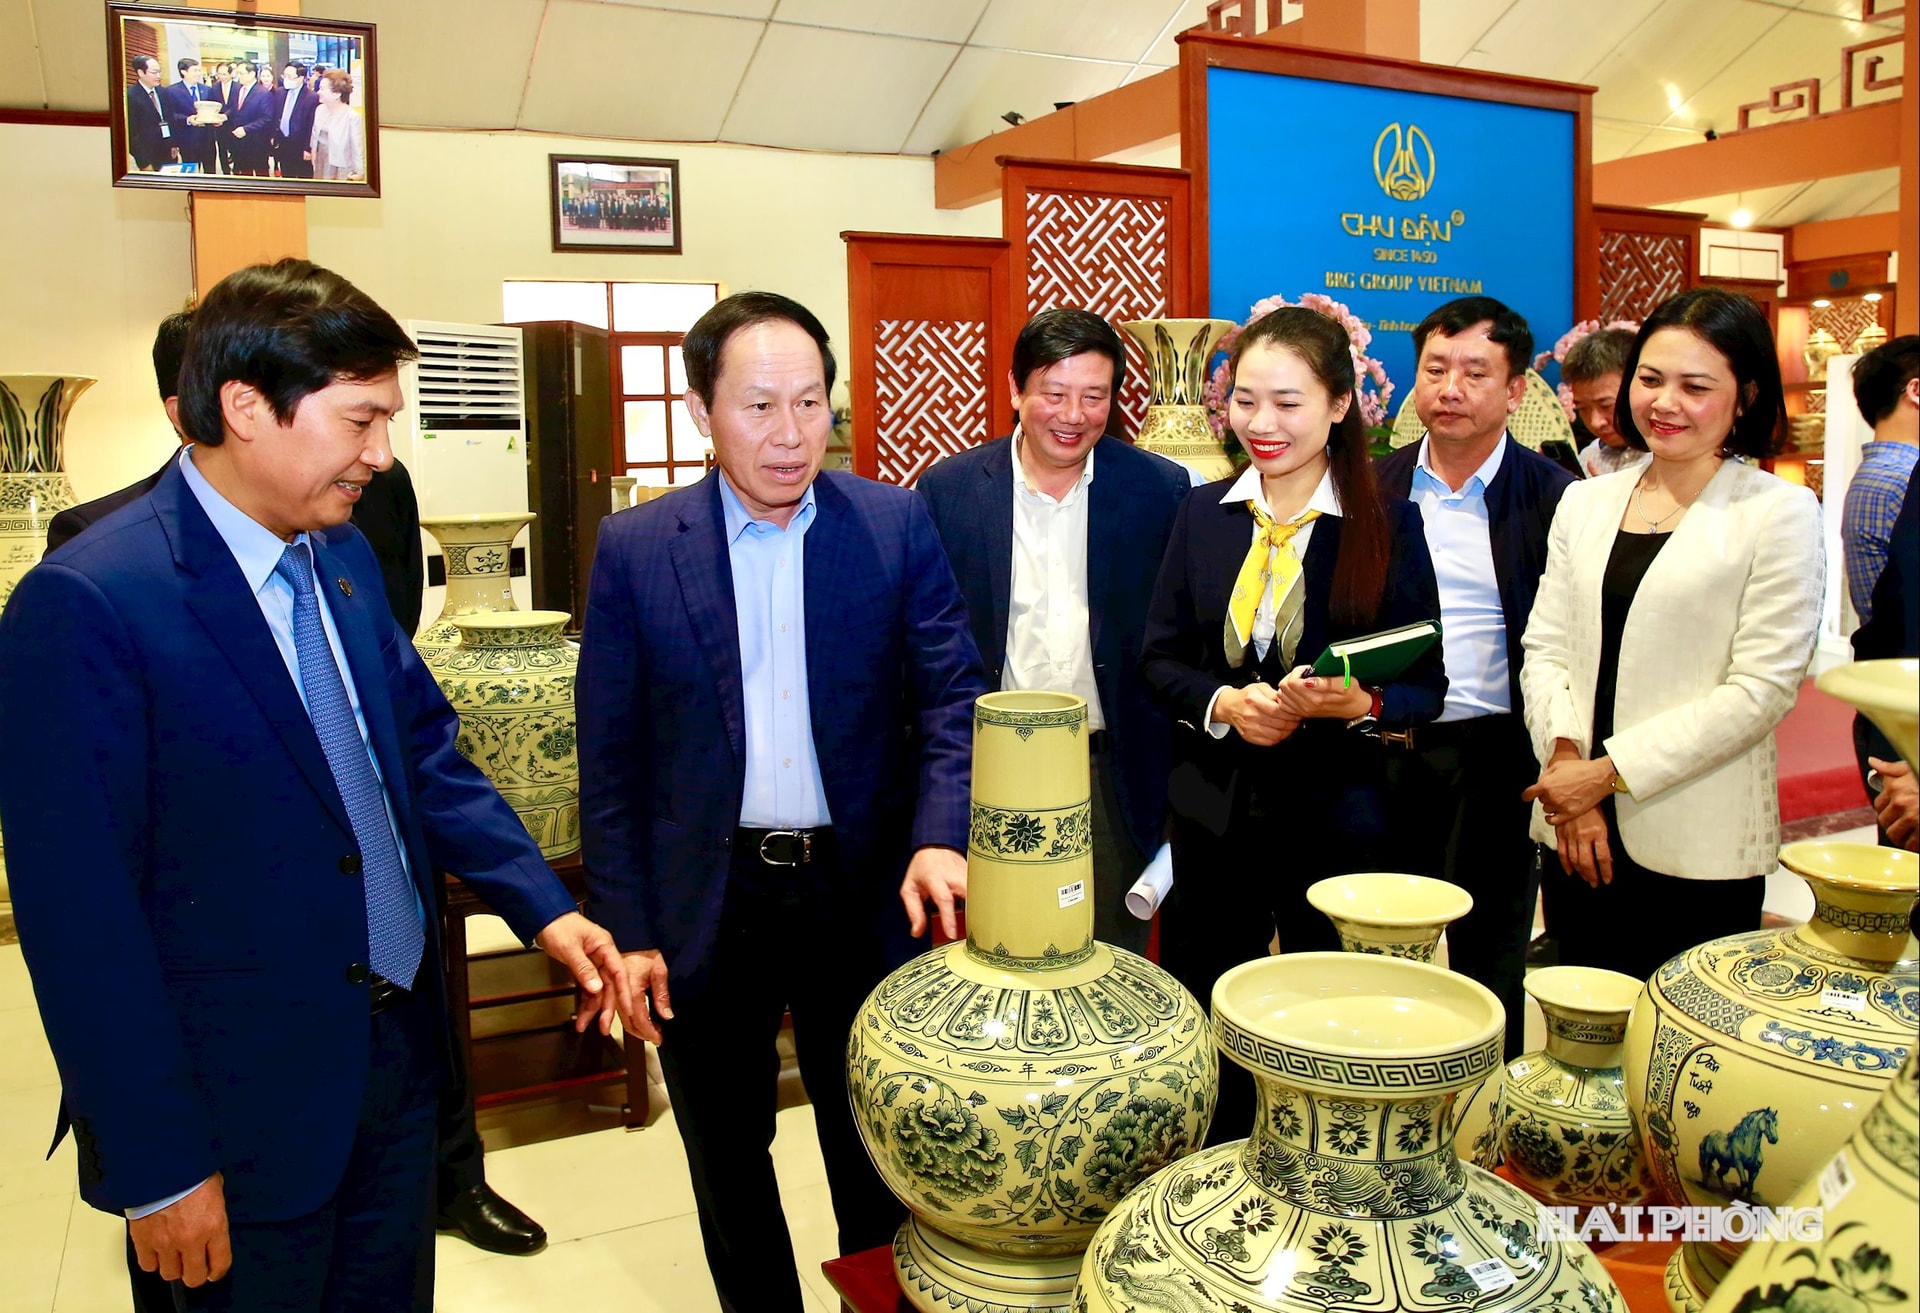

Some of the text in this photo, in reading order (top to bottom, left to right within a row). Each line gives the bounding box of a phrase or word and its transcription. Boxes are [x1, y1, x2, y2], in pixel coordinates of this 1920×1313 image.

[1341, 213, 1394, 239] CHU
[1373, 248, 1408, 263] SINCE
[1325, 271, 1483, 295] BRG GROUP VIETNAM
[1018, 1061, 1037, 1081] 年
